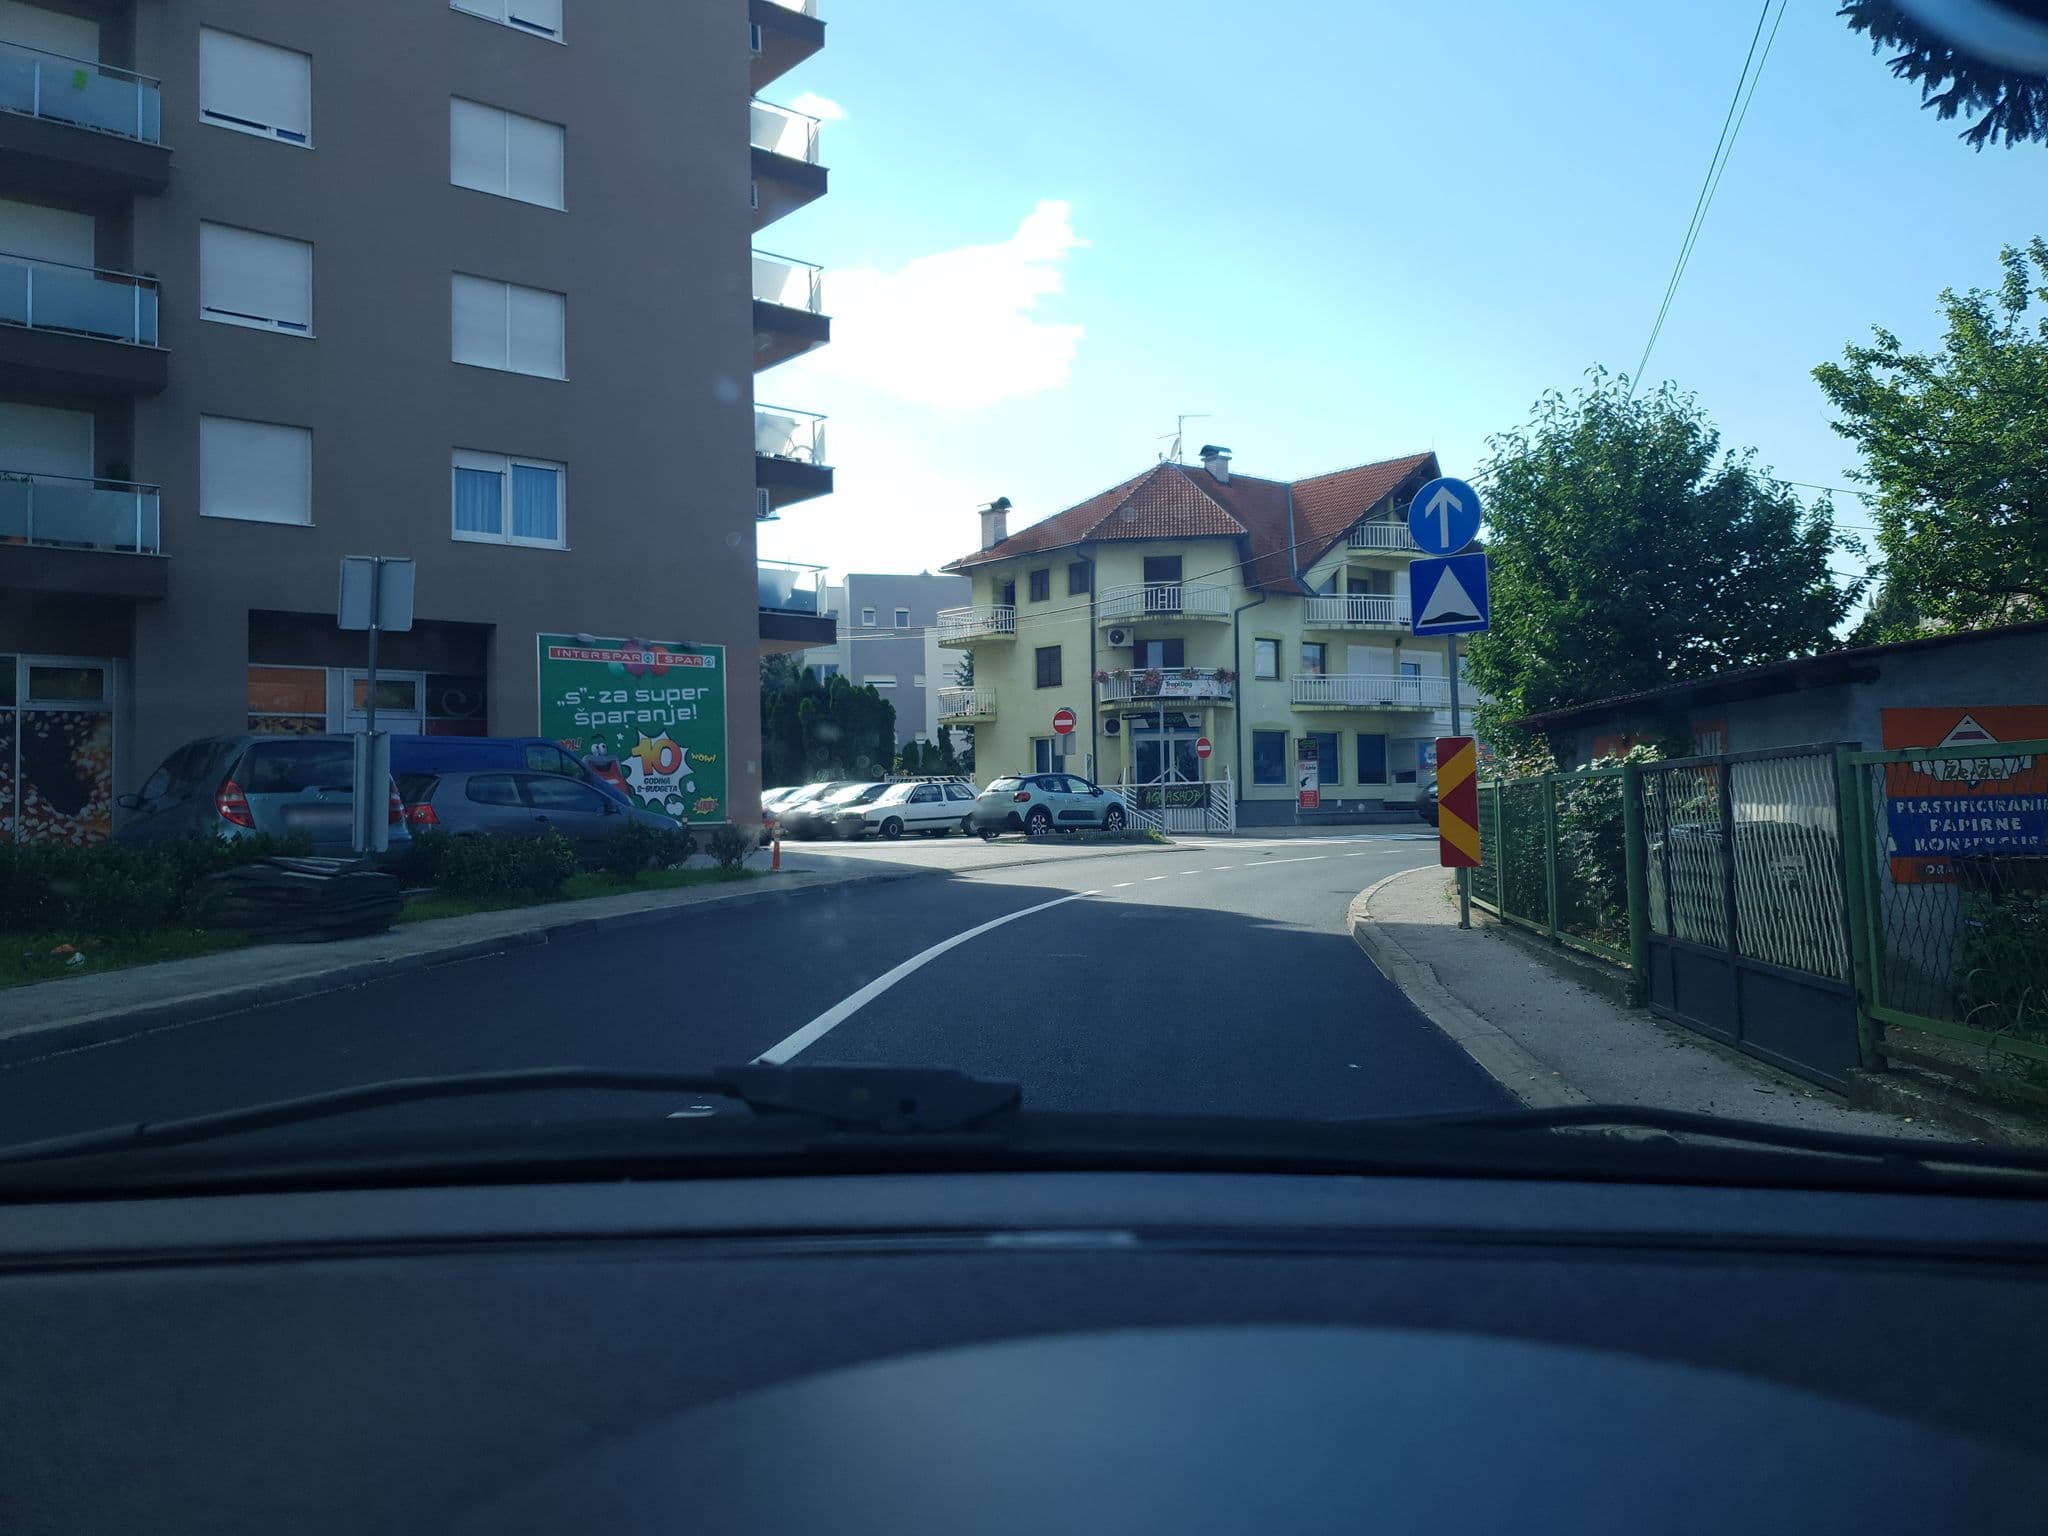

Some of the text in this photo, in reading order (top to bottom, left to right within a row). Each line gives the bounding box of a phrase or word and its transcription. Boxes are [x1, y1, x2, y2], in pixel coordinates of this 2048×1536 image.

[557, 649, 703, 665] INTERSPAR SPAR
[635, 688, 710, 706] super
[574, 704, 698, 729] šparanje!
[631, 738, 682, 777] 10
[637, 785, 678, 793] S-BUDGETA
[643, 777, 671, 786] GODINA
[1930, 817, 2022, 832] PAPIRNE
